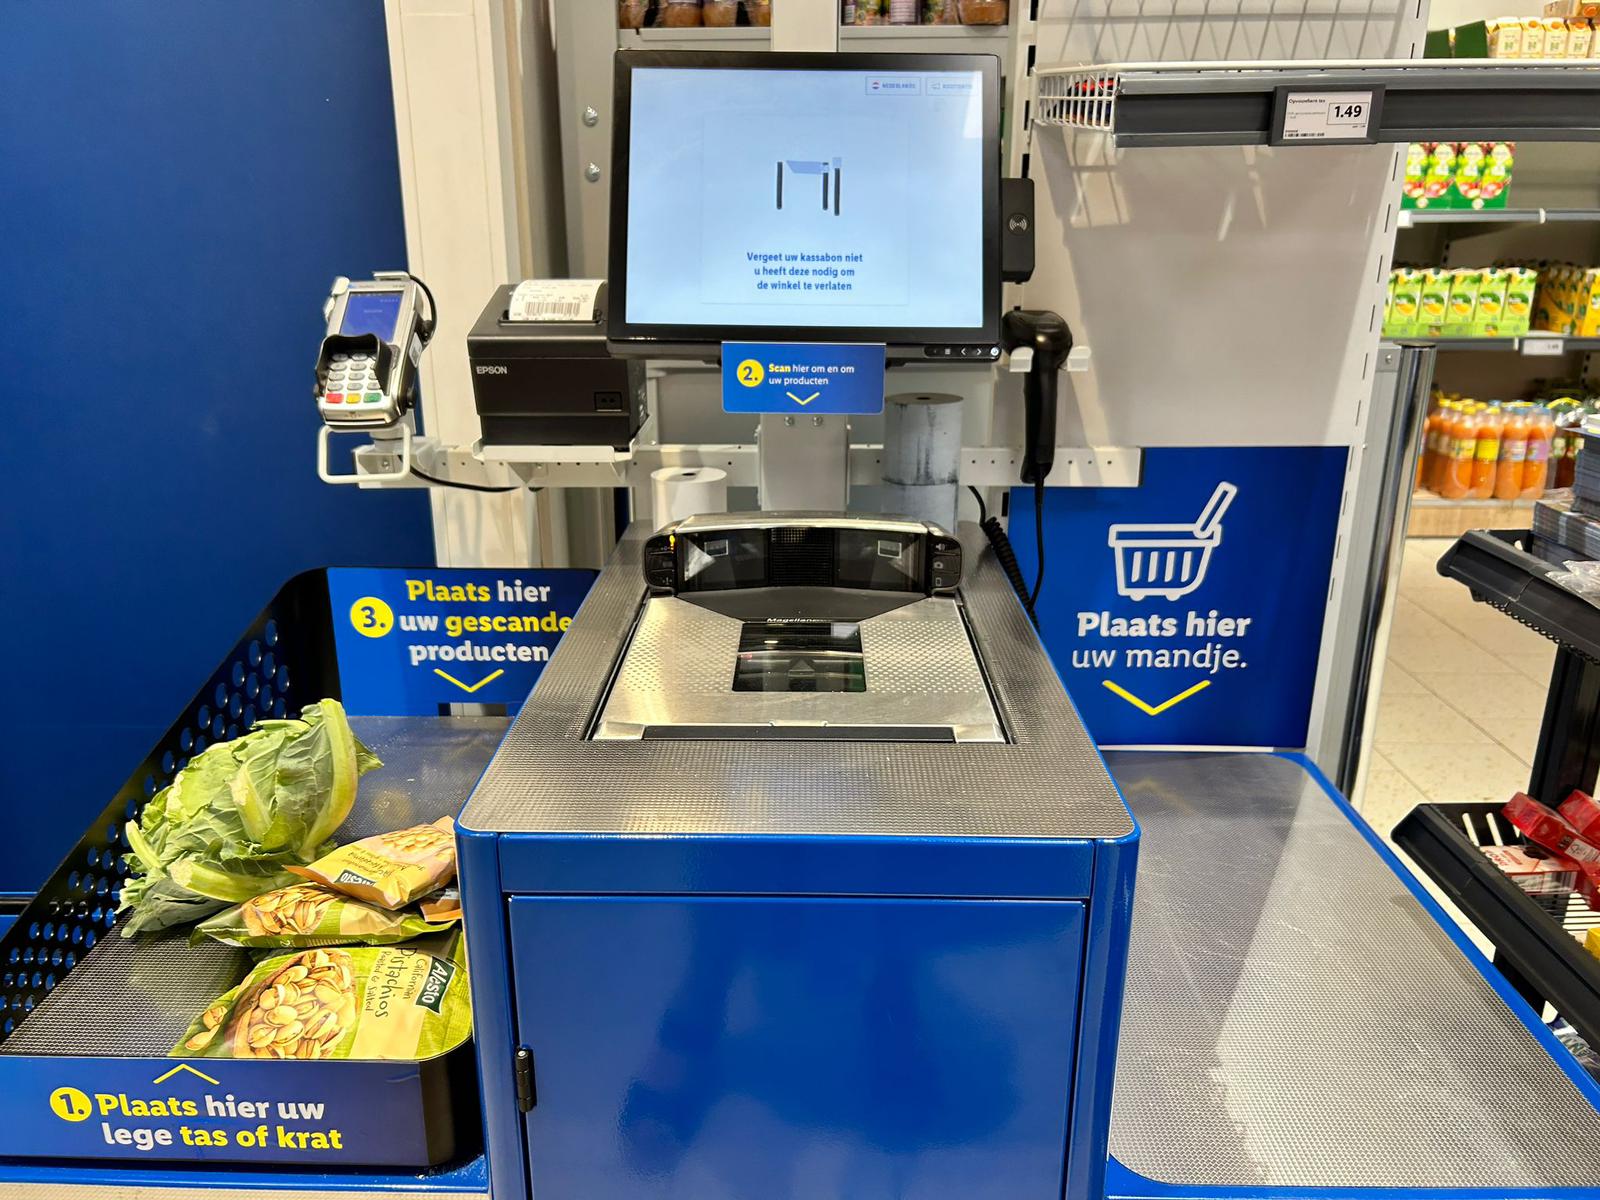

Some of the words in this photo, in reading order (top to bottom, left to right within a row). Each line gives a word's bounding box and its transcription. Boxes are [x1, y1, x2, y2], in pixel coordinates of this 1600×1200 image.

[1334, 104, 1362, 118] 1.49
[747, 252, 782, 263] Vergeet
[785, 254, 798, 262] uw
[800, 252, 843, 262] kassabon
[845, 253, 863, 262] niet
[762, 266, 786, 276] heeft
[789, 267, 810, 276] deze
[812, 267, 838, 278] nodig
[840, 268, 855, 276] om
[757, 281, 768, 290] de
[770, 281, 801, 290] winkel
[803, 282, 812, 290] te
[815, 281, 852, 290] verlaten
[476, 366, 508, 374] EPSON
[743, 366, 759, 381] 2.
[768, 363, 791, 373] Scan
[792, 363, 809, 373] hier
[769, 377, 782, 385] uw
[784, 376, 829, 386] producten
[405, 579, 491, 602] Plaats
[497, 579, 551, 602] hier
[360, 606, 386, 628] 3.
[399, 614, 439, 631] uw
[445, 611, 573, 637] gescande
[1077, 611, 1178, 637] Plaats
[1185, 610, 1251, 637] hier
[409, 640, 549, 666] producten
[1072, 649, 1116, 668] uw
[1125, 643, 1248, 674] mandje.
[375, 947, 418, 1018] Pistachios
[402, 958, 427, 1000] Californian
[421, 961, 448, 1004] Alesto
[365, 986, 377, 1011] Salted
[60, 1093, 85, 1116] 1.
[94, 1093, 198, 1117] Plaats
[205, 1094, 270, 1119] hier
[277, 1103, 325, 1120] uw
[101, 1122, 173, 1151] lege
[179, 1127, 228, 1146] tas
[236, 1126, 268, 1147] of
[276, 1126, 343, 1149] krat
